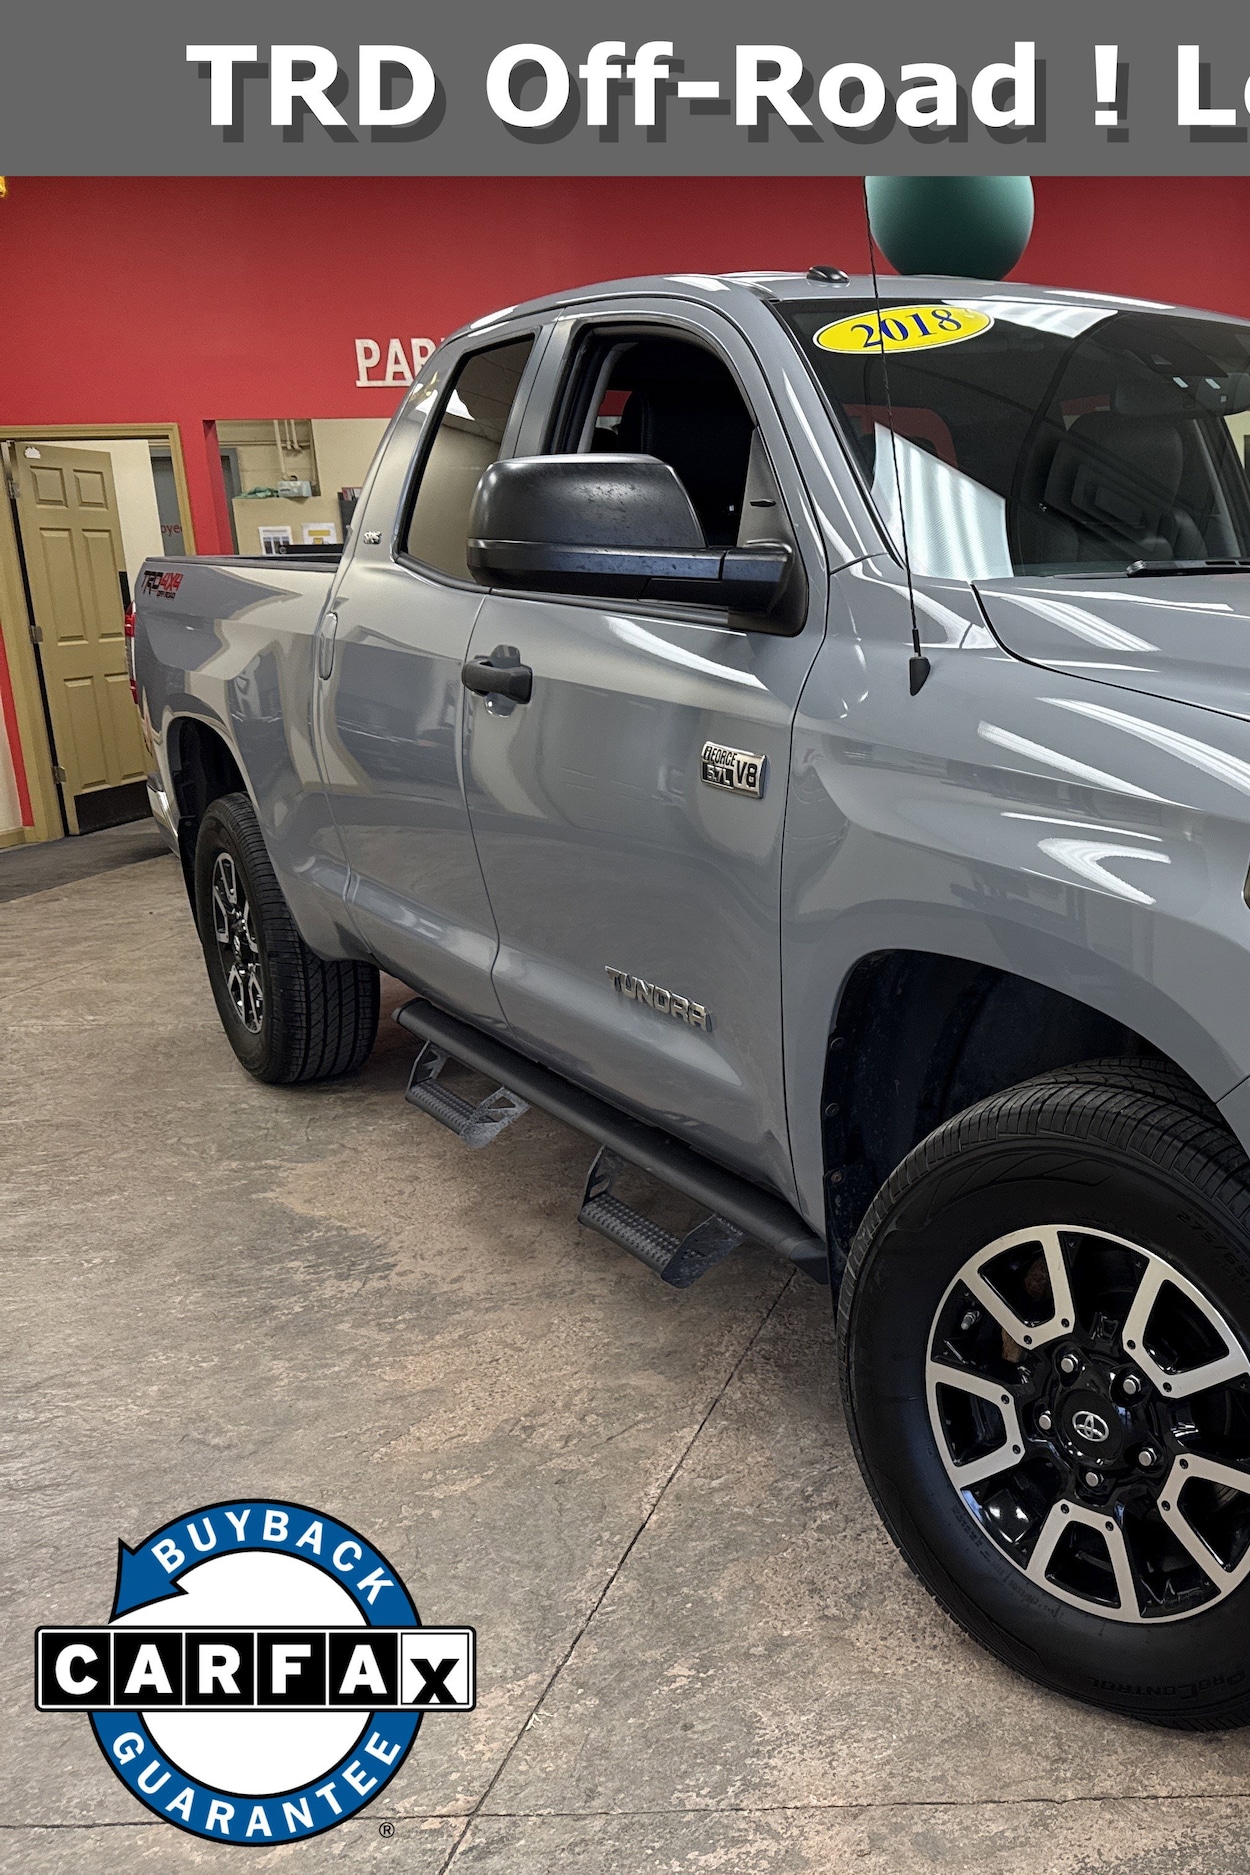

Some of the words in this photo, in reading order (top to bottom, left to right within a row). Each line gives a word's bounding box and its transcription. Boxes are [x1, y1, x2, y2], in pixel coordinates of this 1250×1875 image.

[850, 308, 962, 349] 2018
[355, 337, 445, 382] PAR
[160, 524, 183, 537] oye
[736, 760, 758, 788] V8
[604, 965, 711, 1033] TUNDRA
